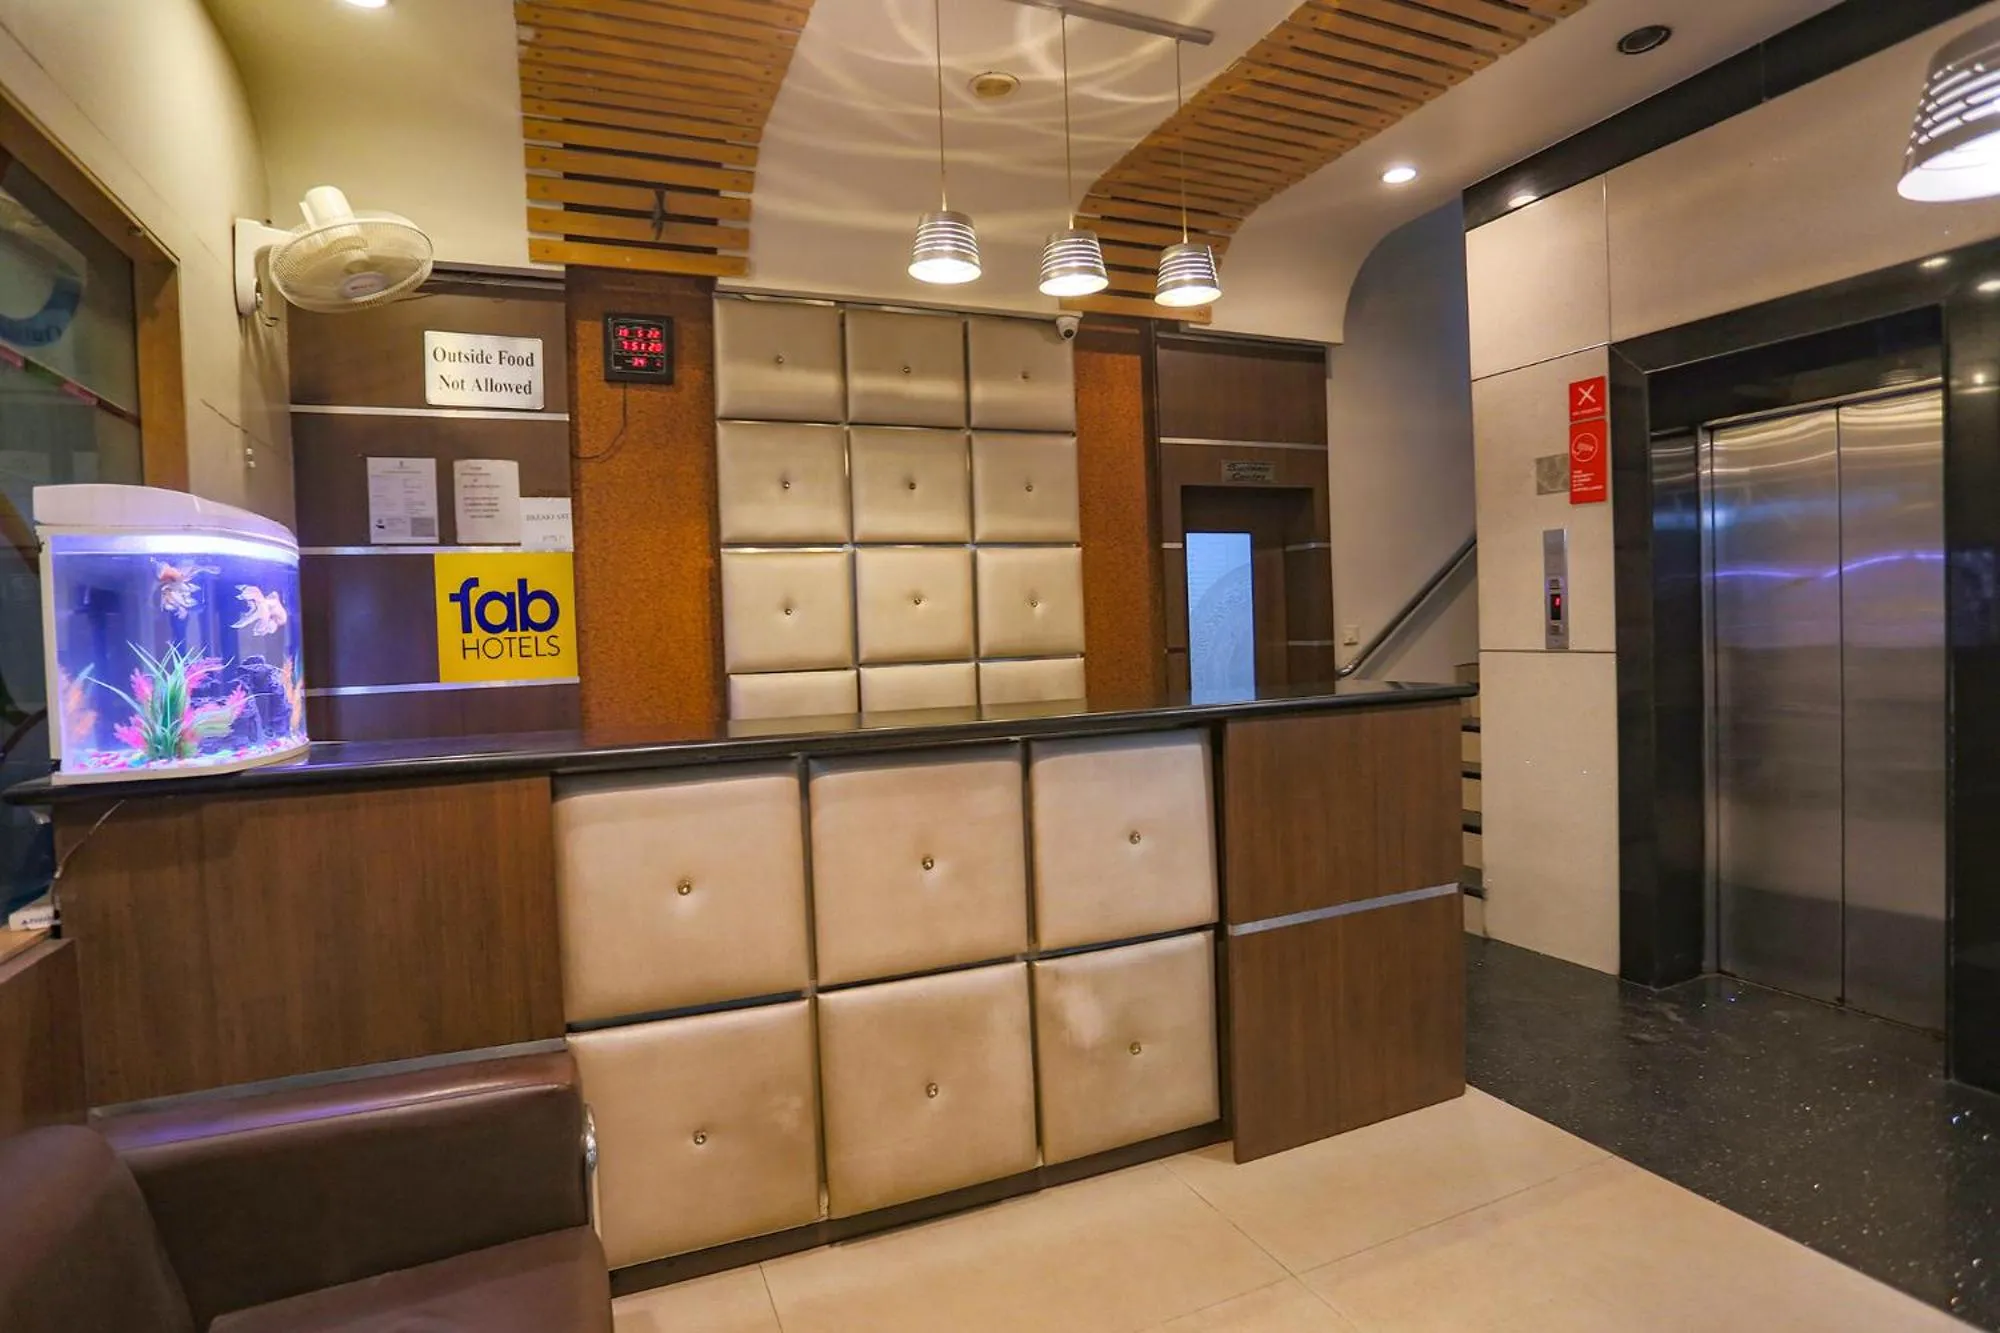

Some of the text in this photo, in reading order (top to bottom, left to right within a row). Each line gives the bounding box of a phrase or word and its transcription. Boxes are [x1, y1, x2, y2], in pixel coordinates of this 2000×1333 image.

[433, 347, 534, 367] Outside Food
[439, 374, 532, 395] Not Allowed
[449, 577, 560, 634] fab
[462, 635, 561, 660] HOTELS
